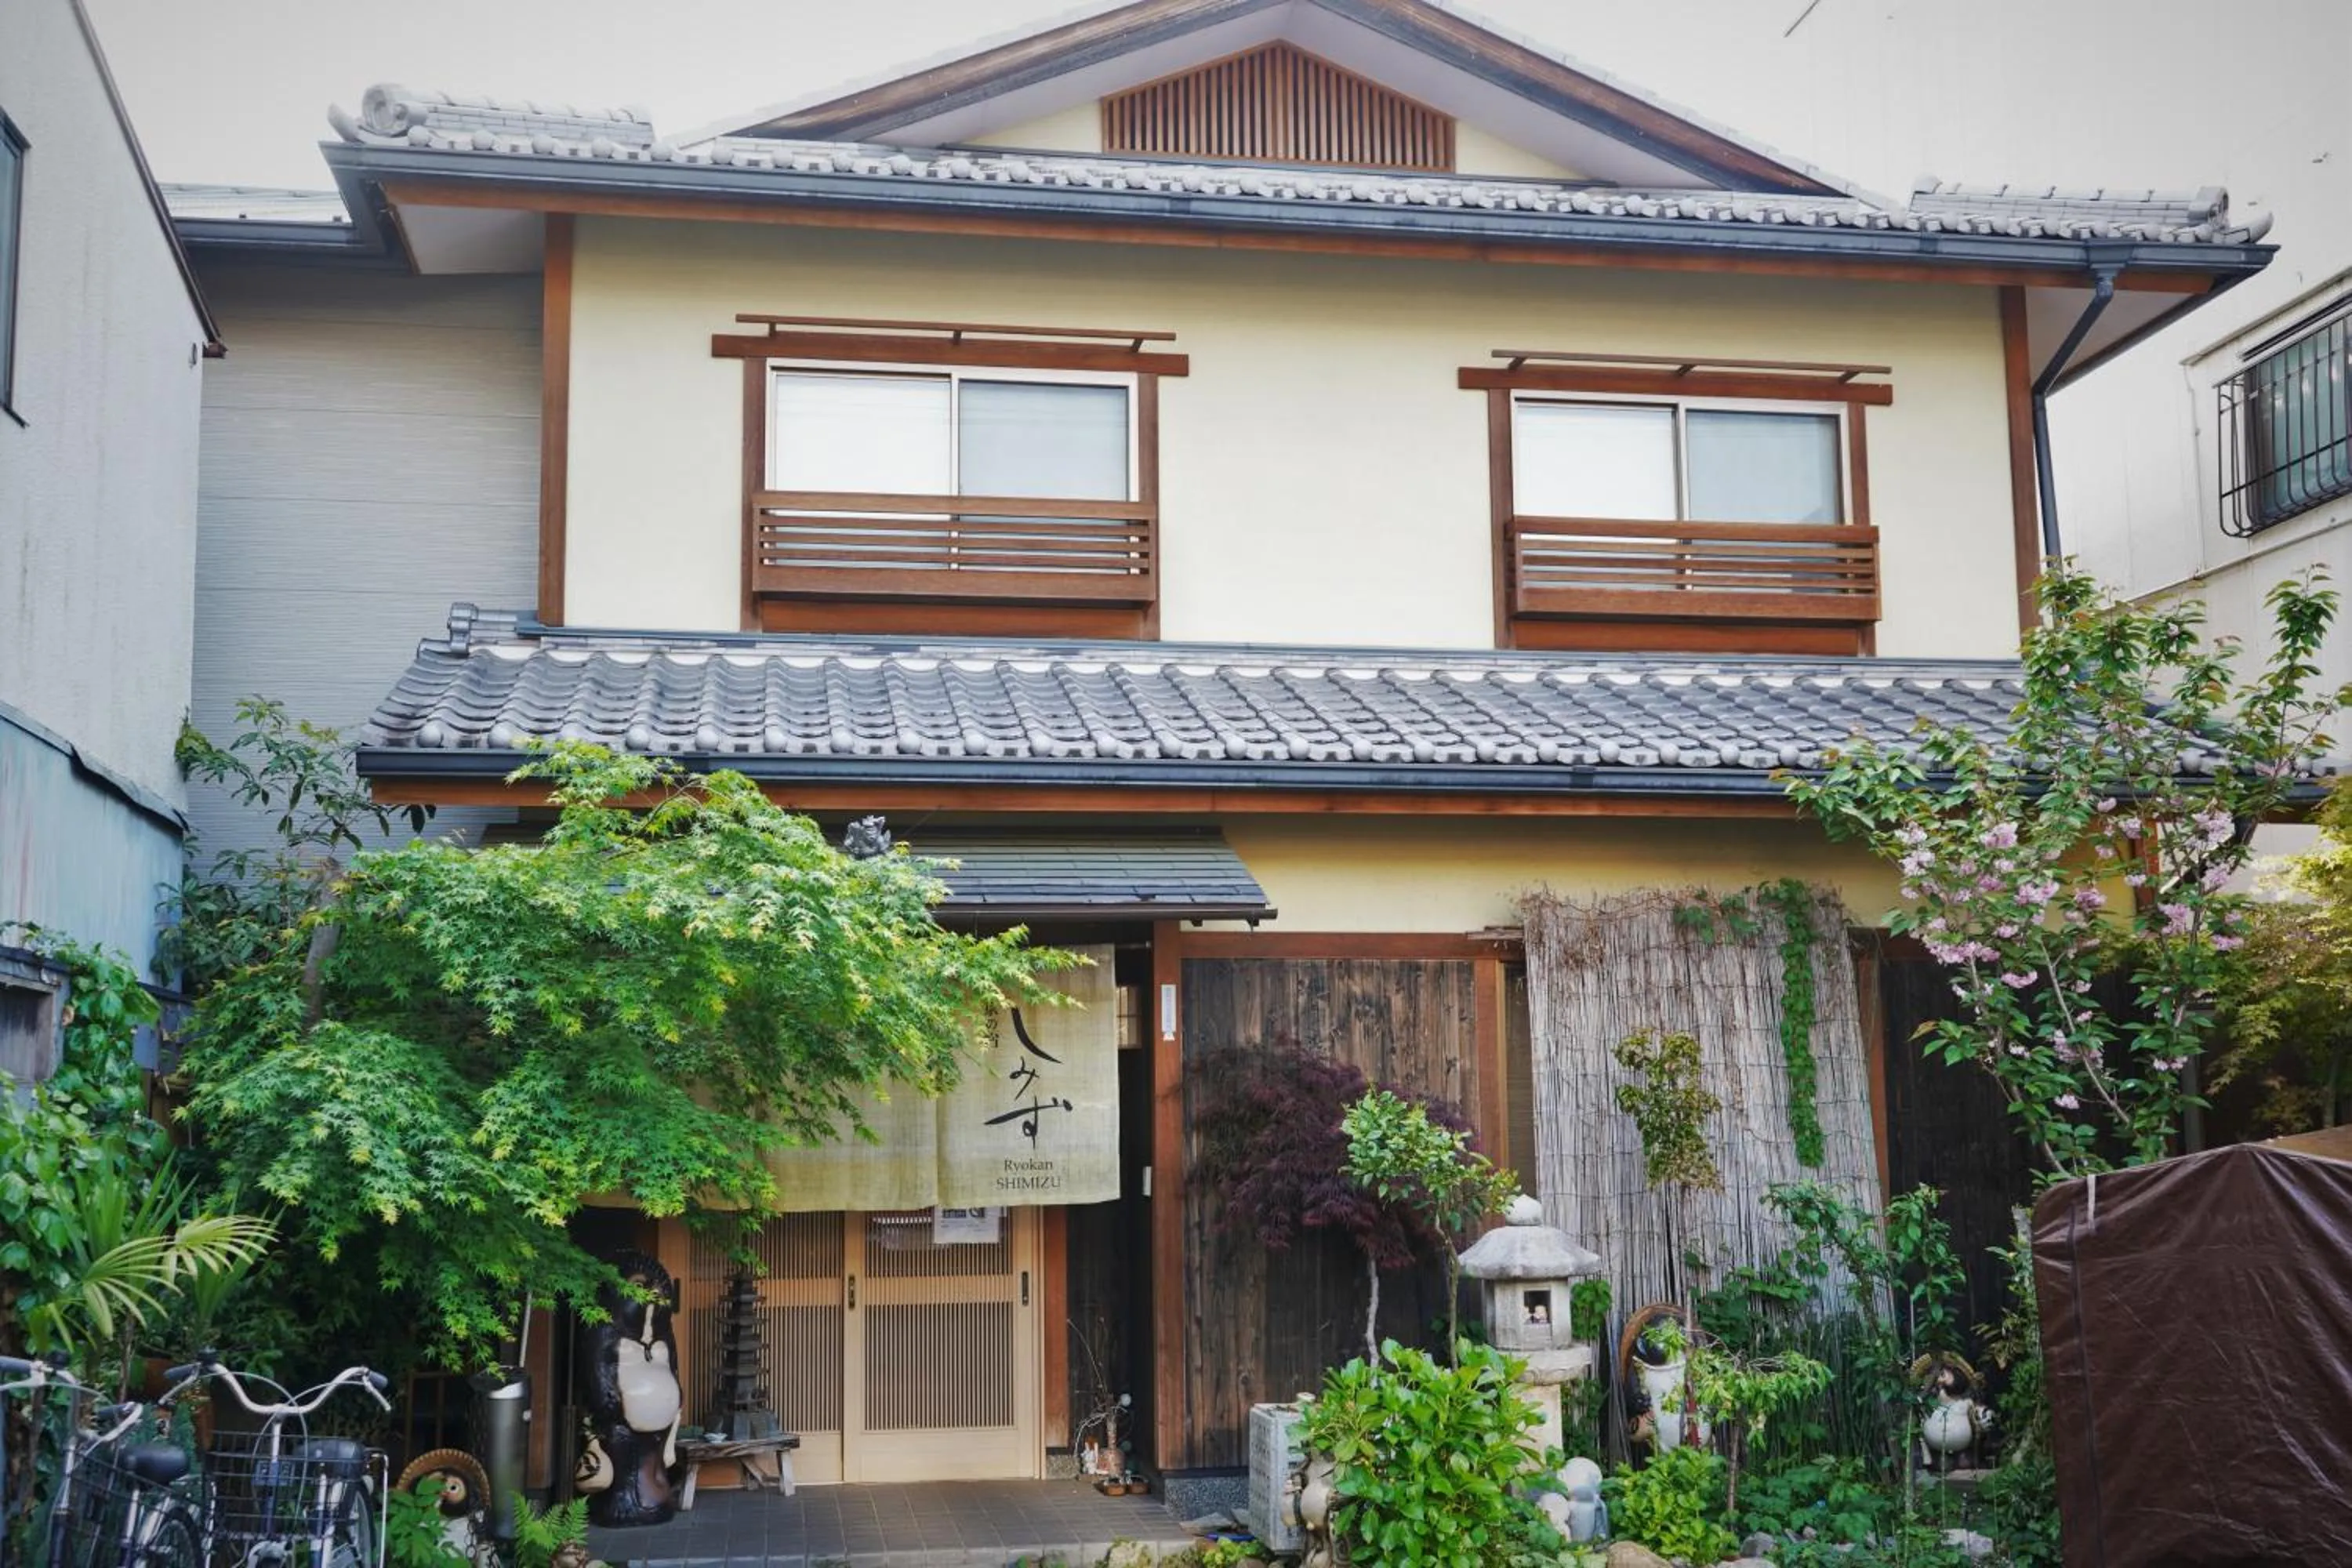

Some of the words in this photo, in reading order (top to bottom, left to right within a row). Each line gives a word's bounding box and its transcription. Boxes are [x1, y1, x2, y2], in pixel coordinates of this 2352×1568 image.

[984, 1007, 1073, 1150] しみず
[1004, 1158, 1053, 1172] Ryokan
[996, 1177, 1061, 1190] SHIMIZU
